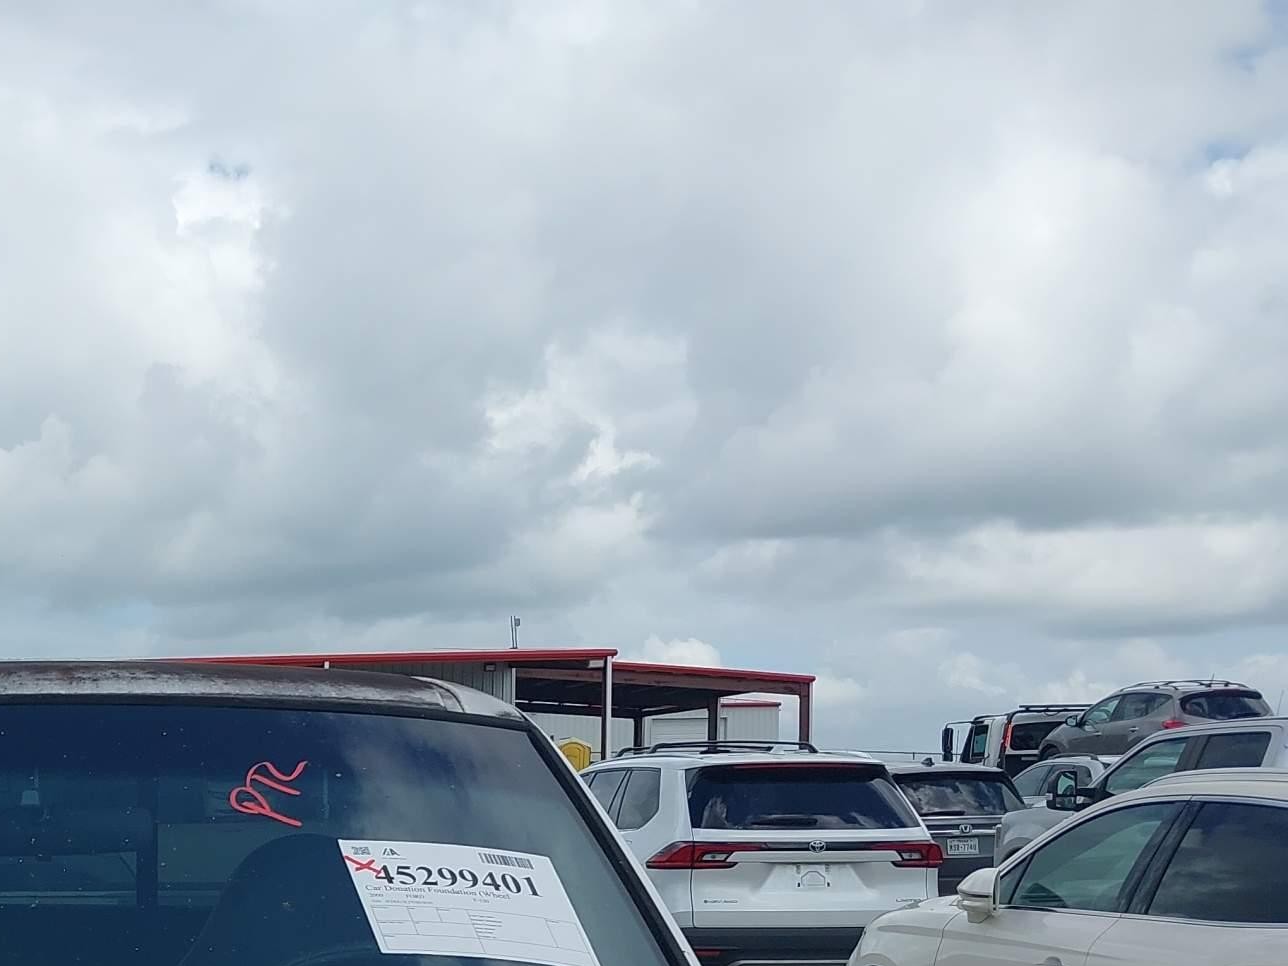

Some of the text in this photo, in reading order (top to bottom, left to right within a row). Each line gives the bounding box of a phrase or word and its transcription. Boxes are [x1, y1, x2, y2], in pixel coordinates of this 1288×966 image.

[375, 864, 543, 897] 45299401
[384, 885, 426, 893] Donation
[428, 886, 477, 896] Foundation
